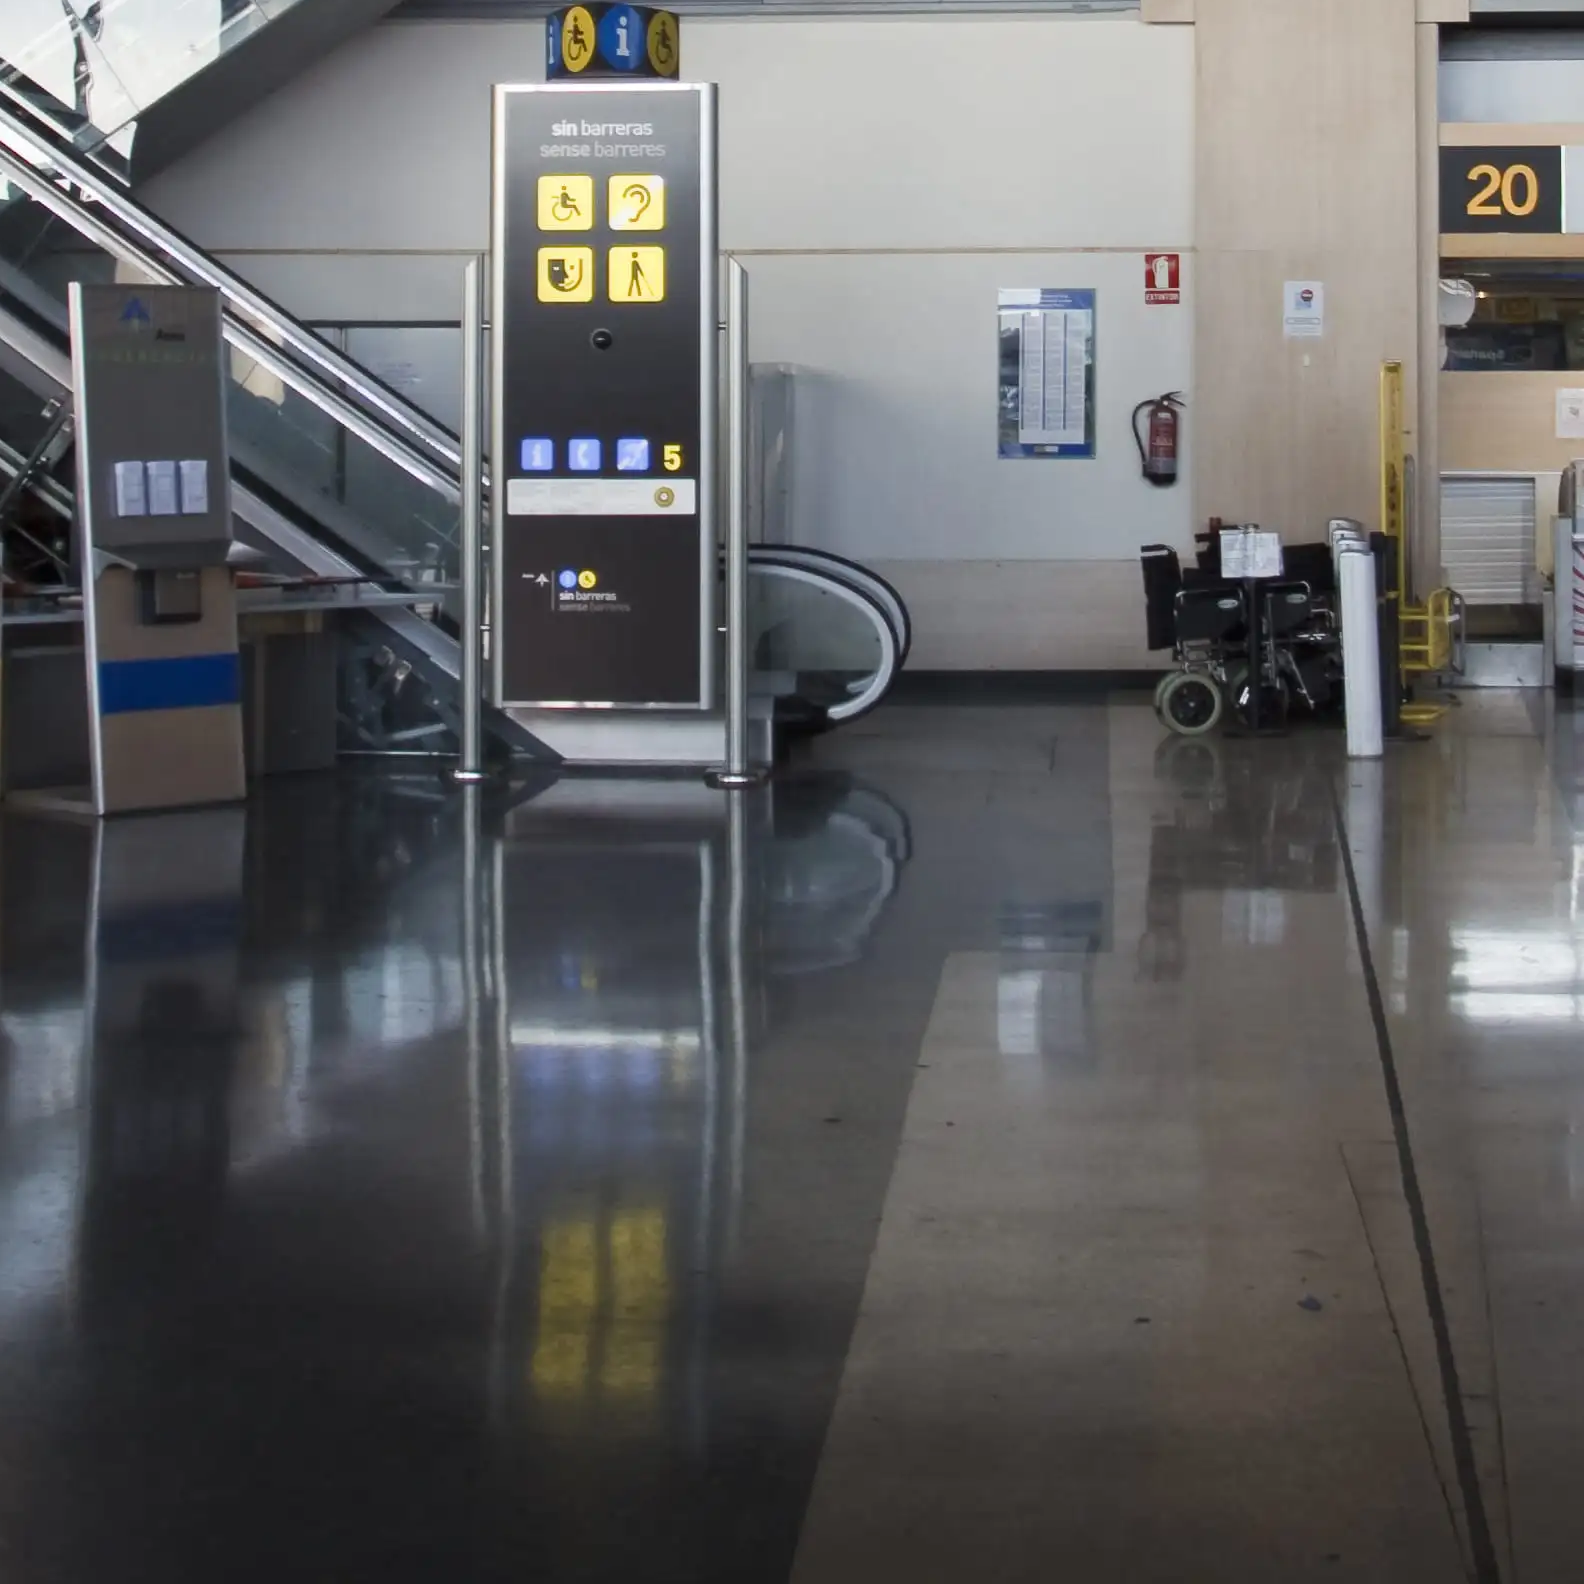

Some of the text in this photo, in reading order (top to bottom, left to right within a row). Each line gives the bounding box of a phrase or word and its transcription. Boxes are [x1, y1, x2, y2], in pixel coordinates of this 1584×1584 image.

[551, 120, 653, 136] sin barreras
[540, 141, 666, 158] sense barreres
[1466, 163, 1539, 216] 20
[663, 444, 682, 471] 5
[559, 590, 617, 601] sin barreras
